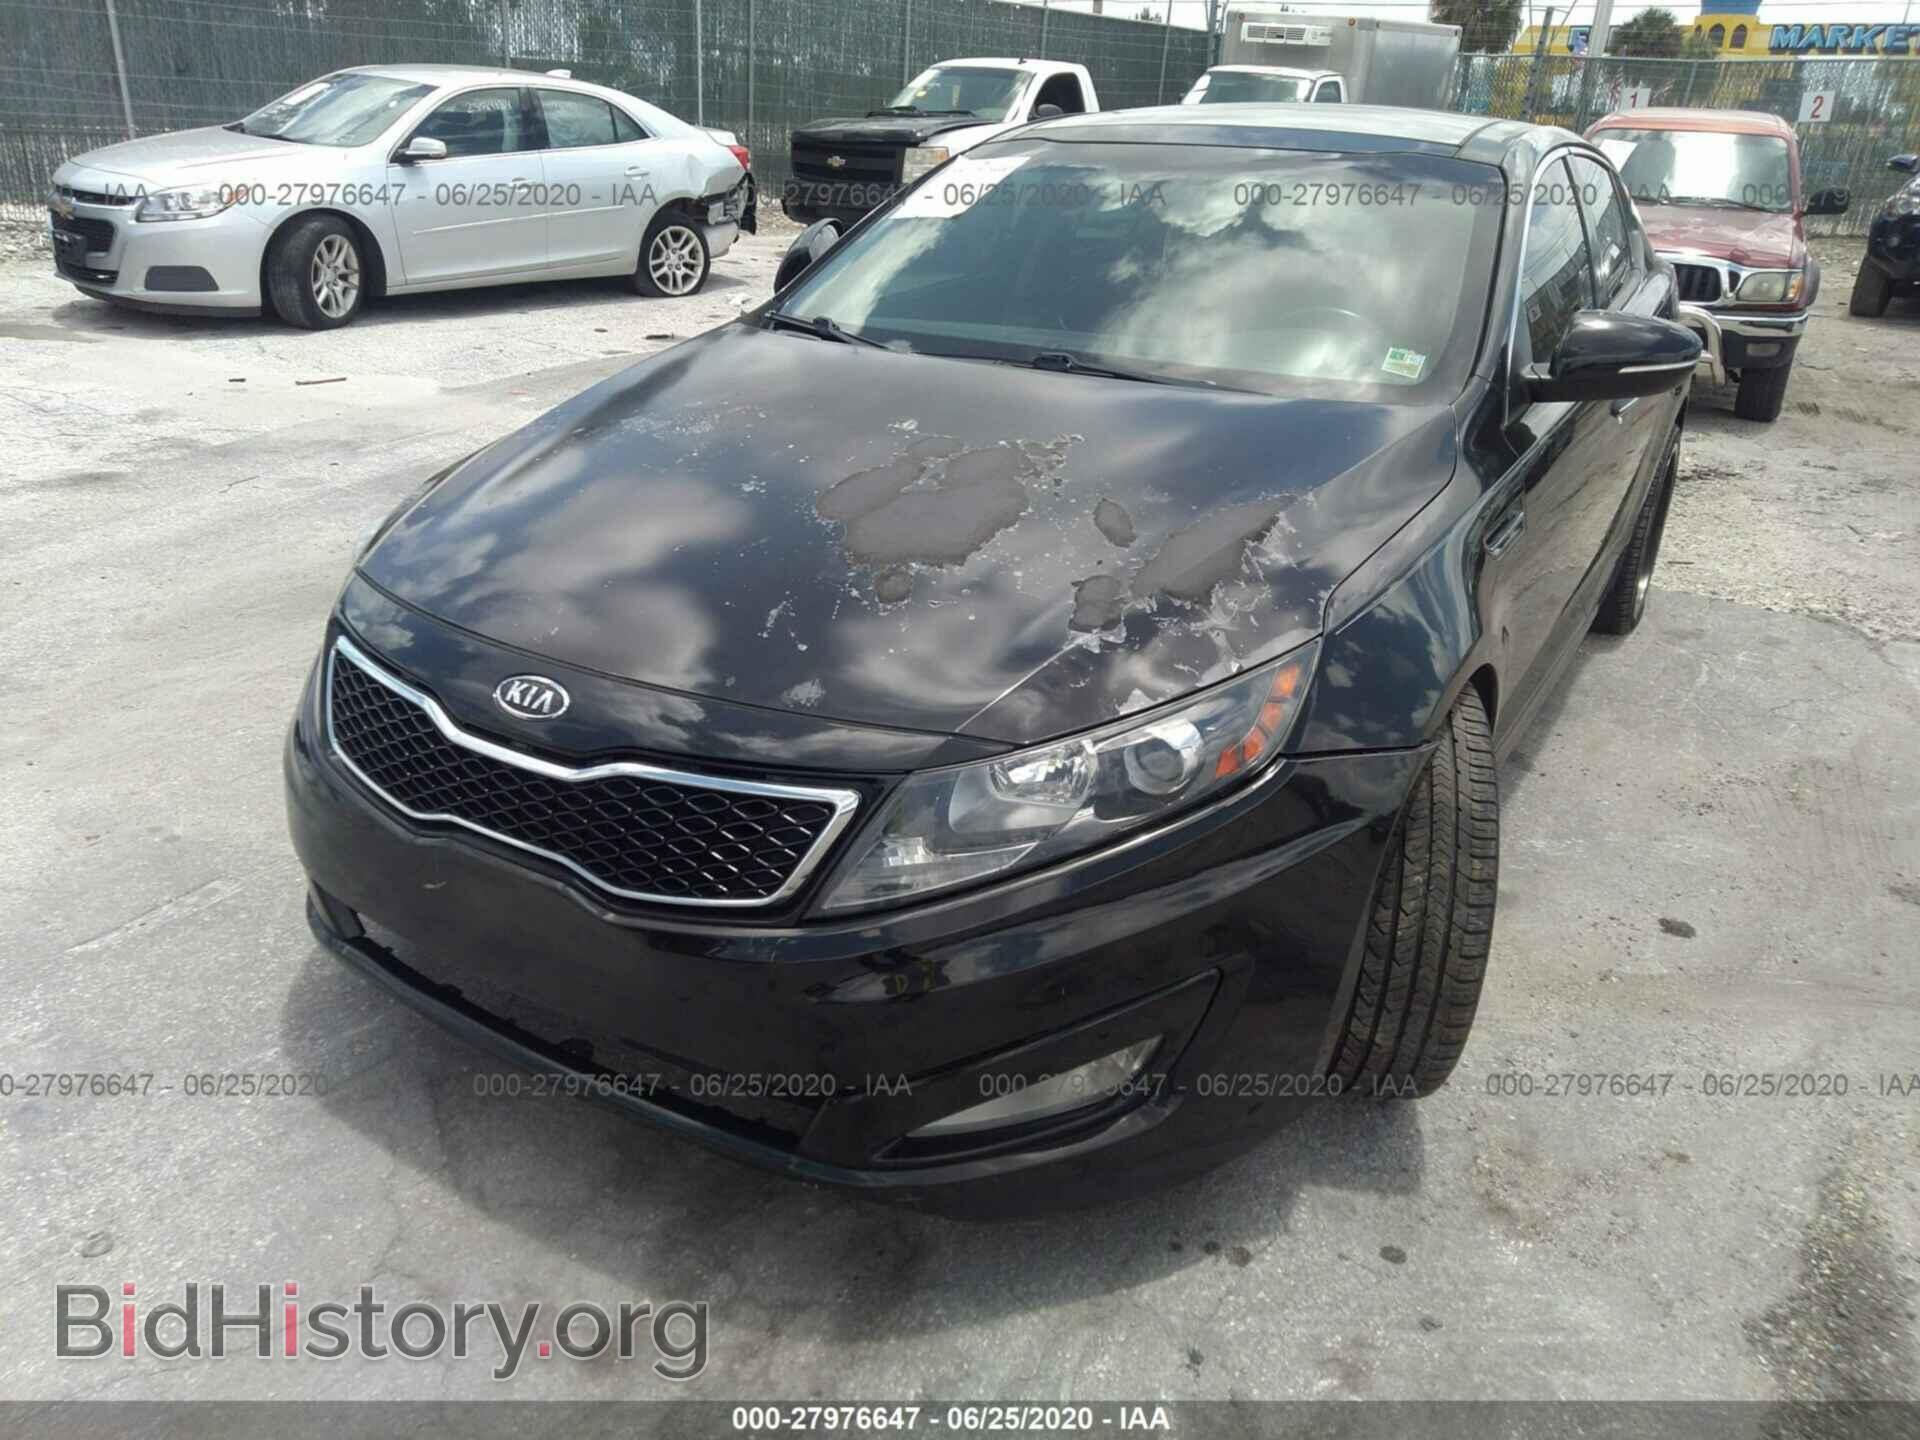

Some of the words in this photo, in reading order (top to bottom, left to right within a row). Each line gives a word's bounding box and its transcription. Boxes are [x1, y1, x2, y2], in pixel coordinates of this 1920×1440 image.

[1629, 91, 1639, 109] 1
[1810, 95, 1825, 119] 2
[505, 680, 555, 714] KIA
